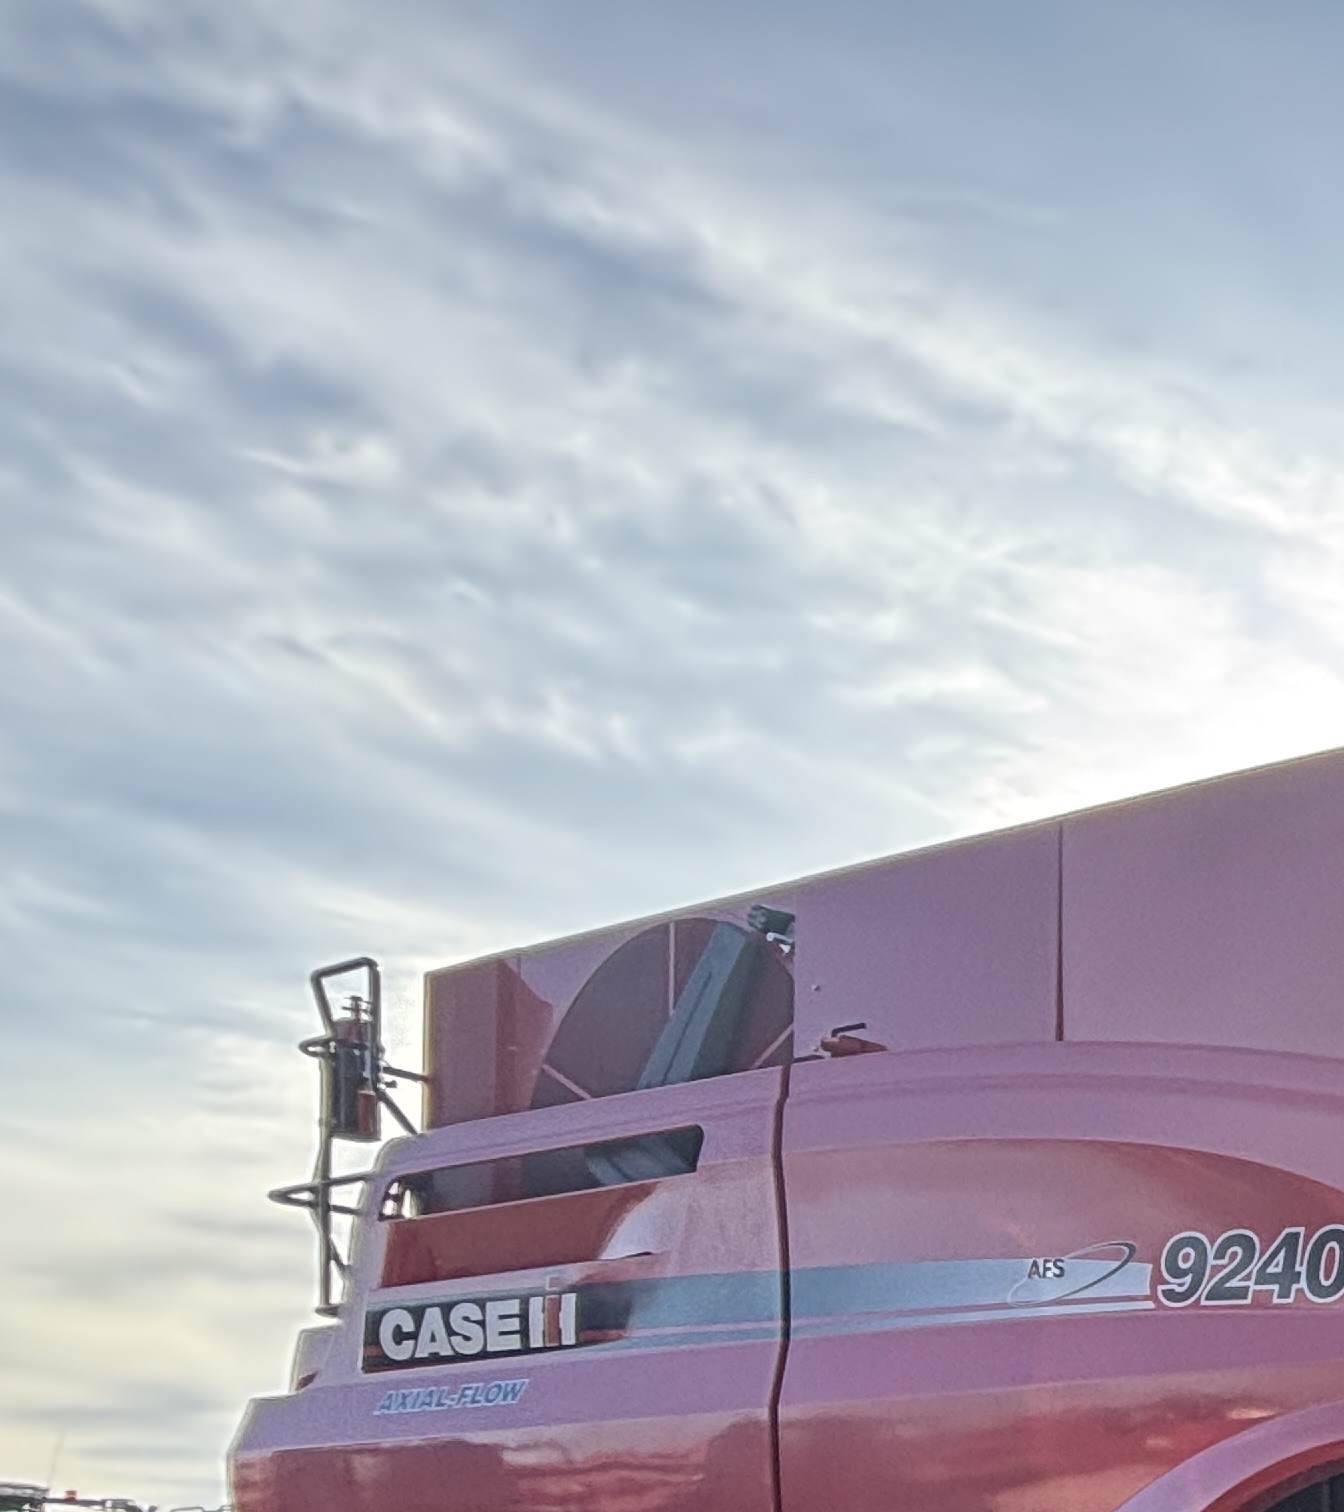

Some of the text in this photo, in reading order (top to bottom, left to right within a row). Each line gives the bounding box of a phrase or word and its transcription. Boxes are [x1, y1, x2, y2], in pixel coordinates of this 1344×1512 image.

[1027, 1258, 1066, 1280] AFS
[379, 1299, 522, 1361] CASE
[373, 1378, 530, 1416] AXIAL-FLOW
